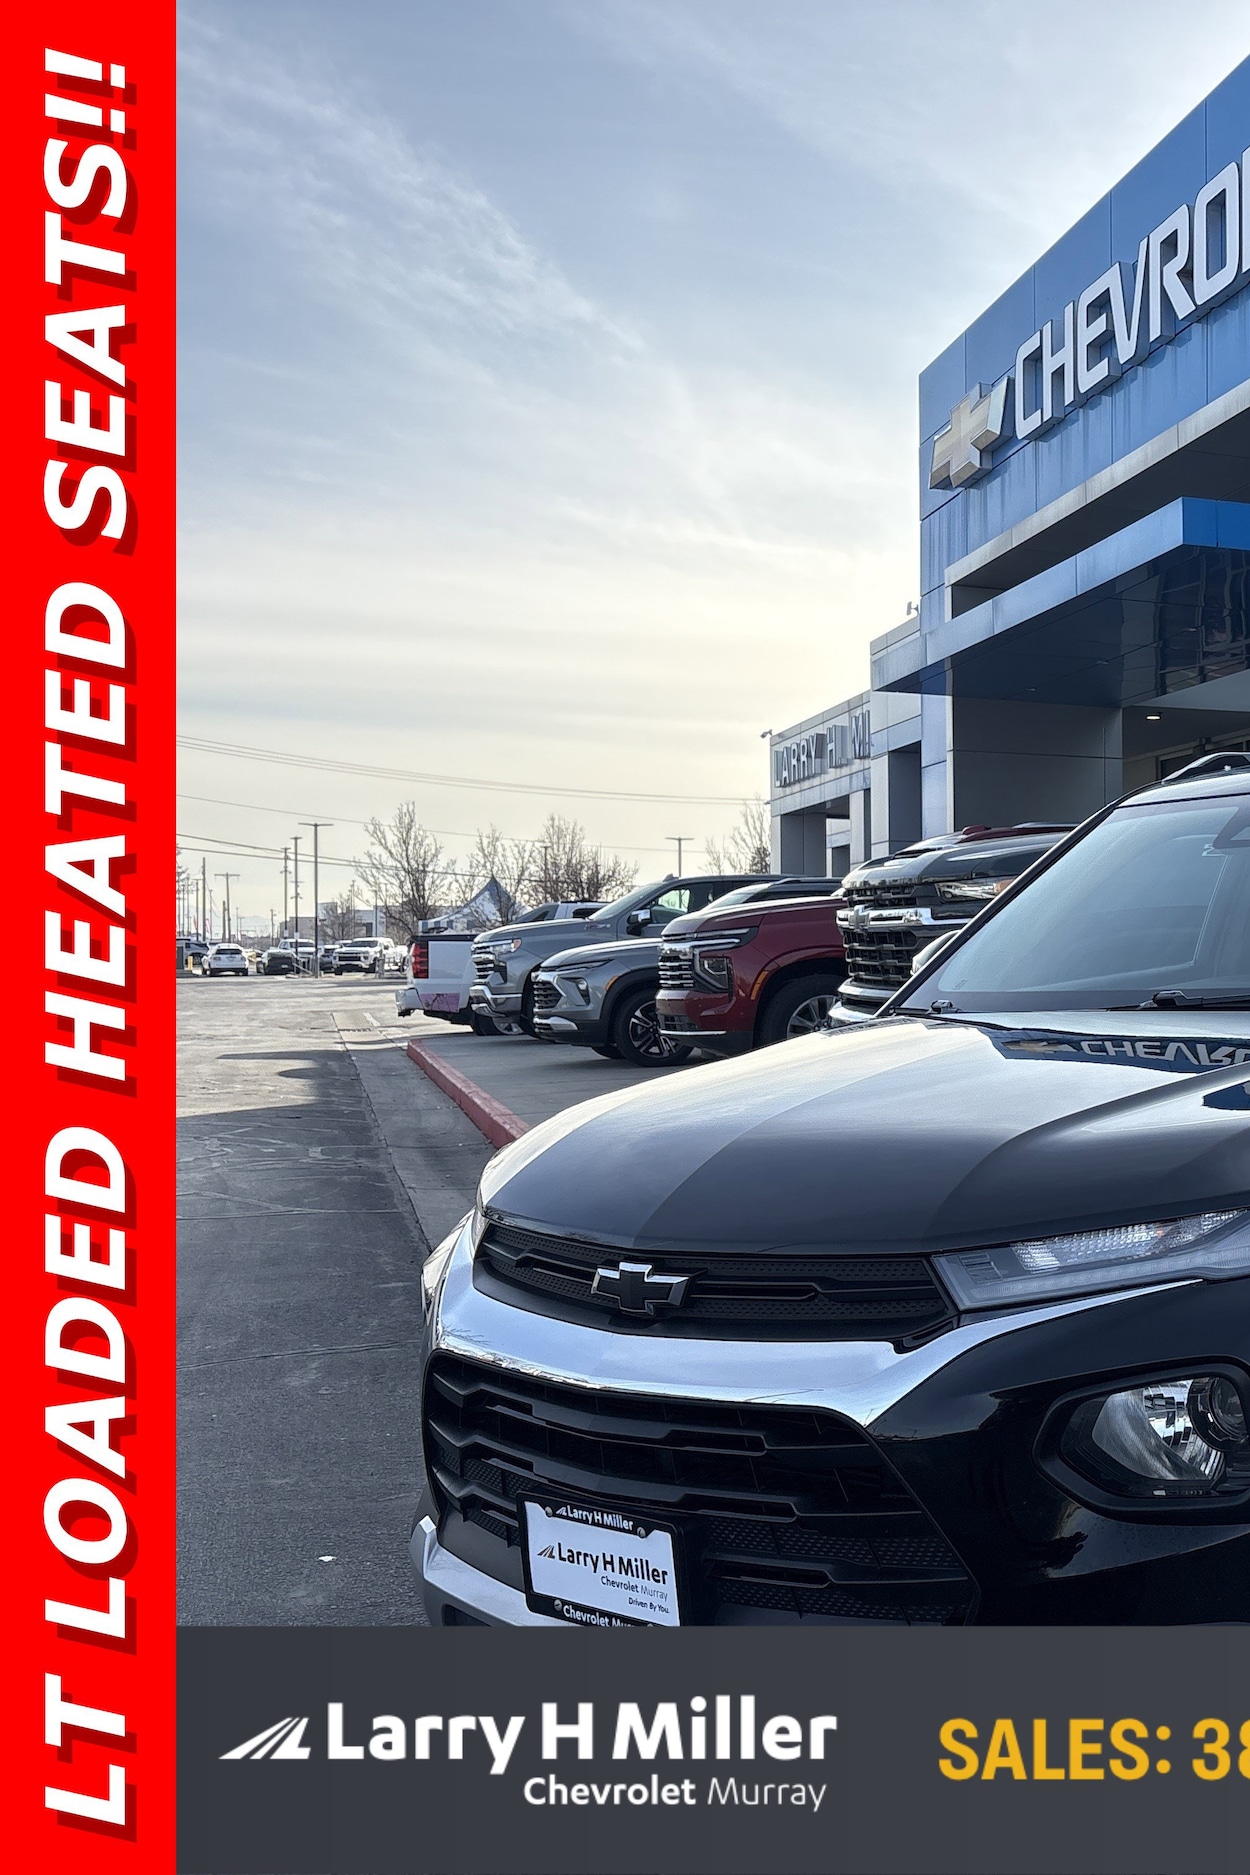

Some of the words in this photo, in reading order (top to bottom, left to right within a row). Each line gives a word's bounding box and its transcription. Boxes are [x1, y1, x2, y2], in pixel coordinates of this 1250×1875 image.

[774, 732, 820, 788] LARRY
[567, 1505, 593, 1524] Larry
[594, 1511, 602, 1524] H
[603, 1513, 634, 1531] Miller
[558, 1542, 599, 1574] Larry
[602, 1552, 615, 1573] H
[618, 1556, 668, 1585] Miller
[601, 1576, 640, 1594] Chevrolet
[640, 1584, 668, 1602] Murray
[563, 1605, 610, 1626] Chevrolet
[628, 1597, 648, 1609] Driven
[649, 1601, 658, 1612] By
